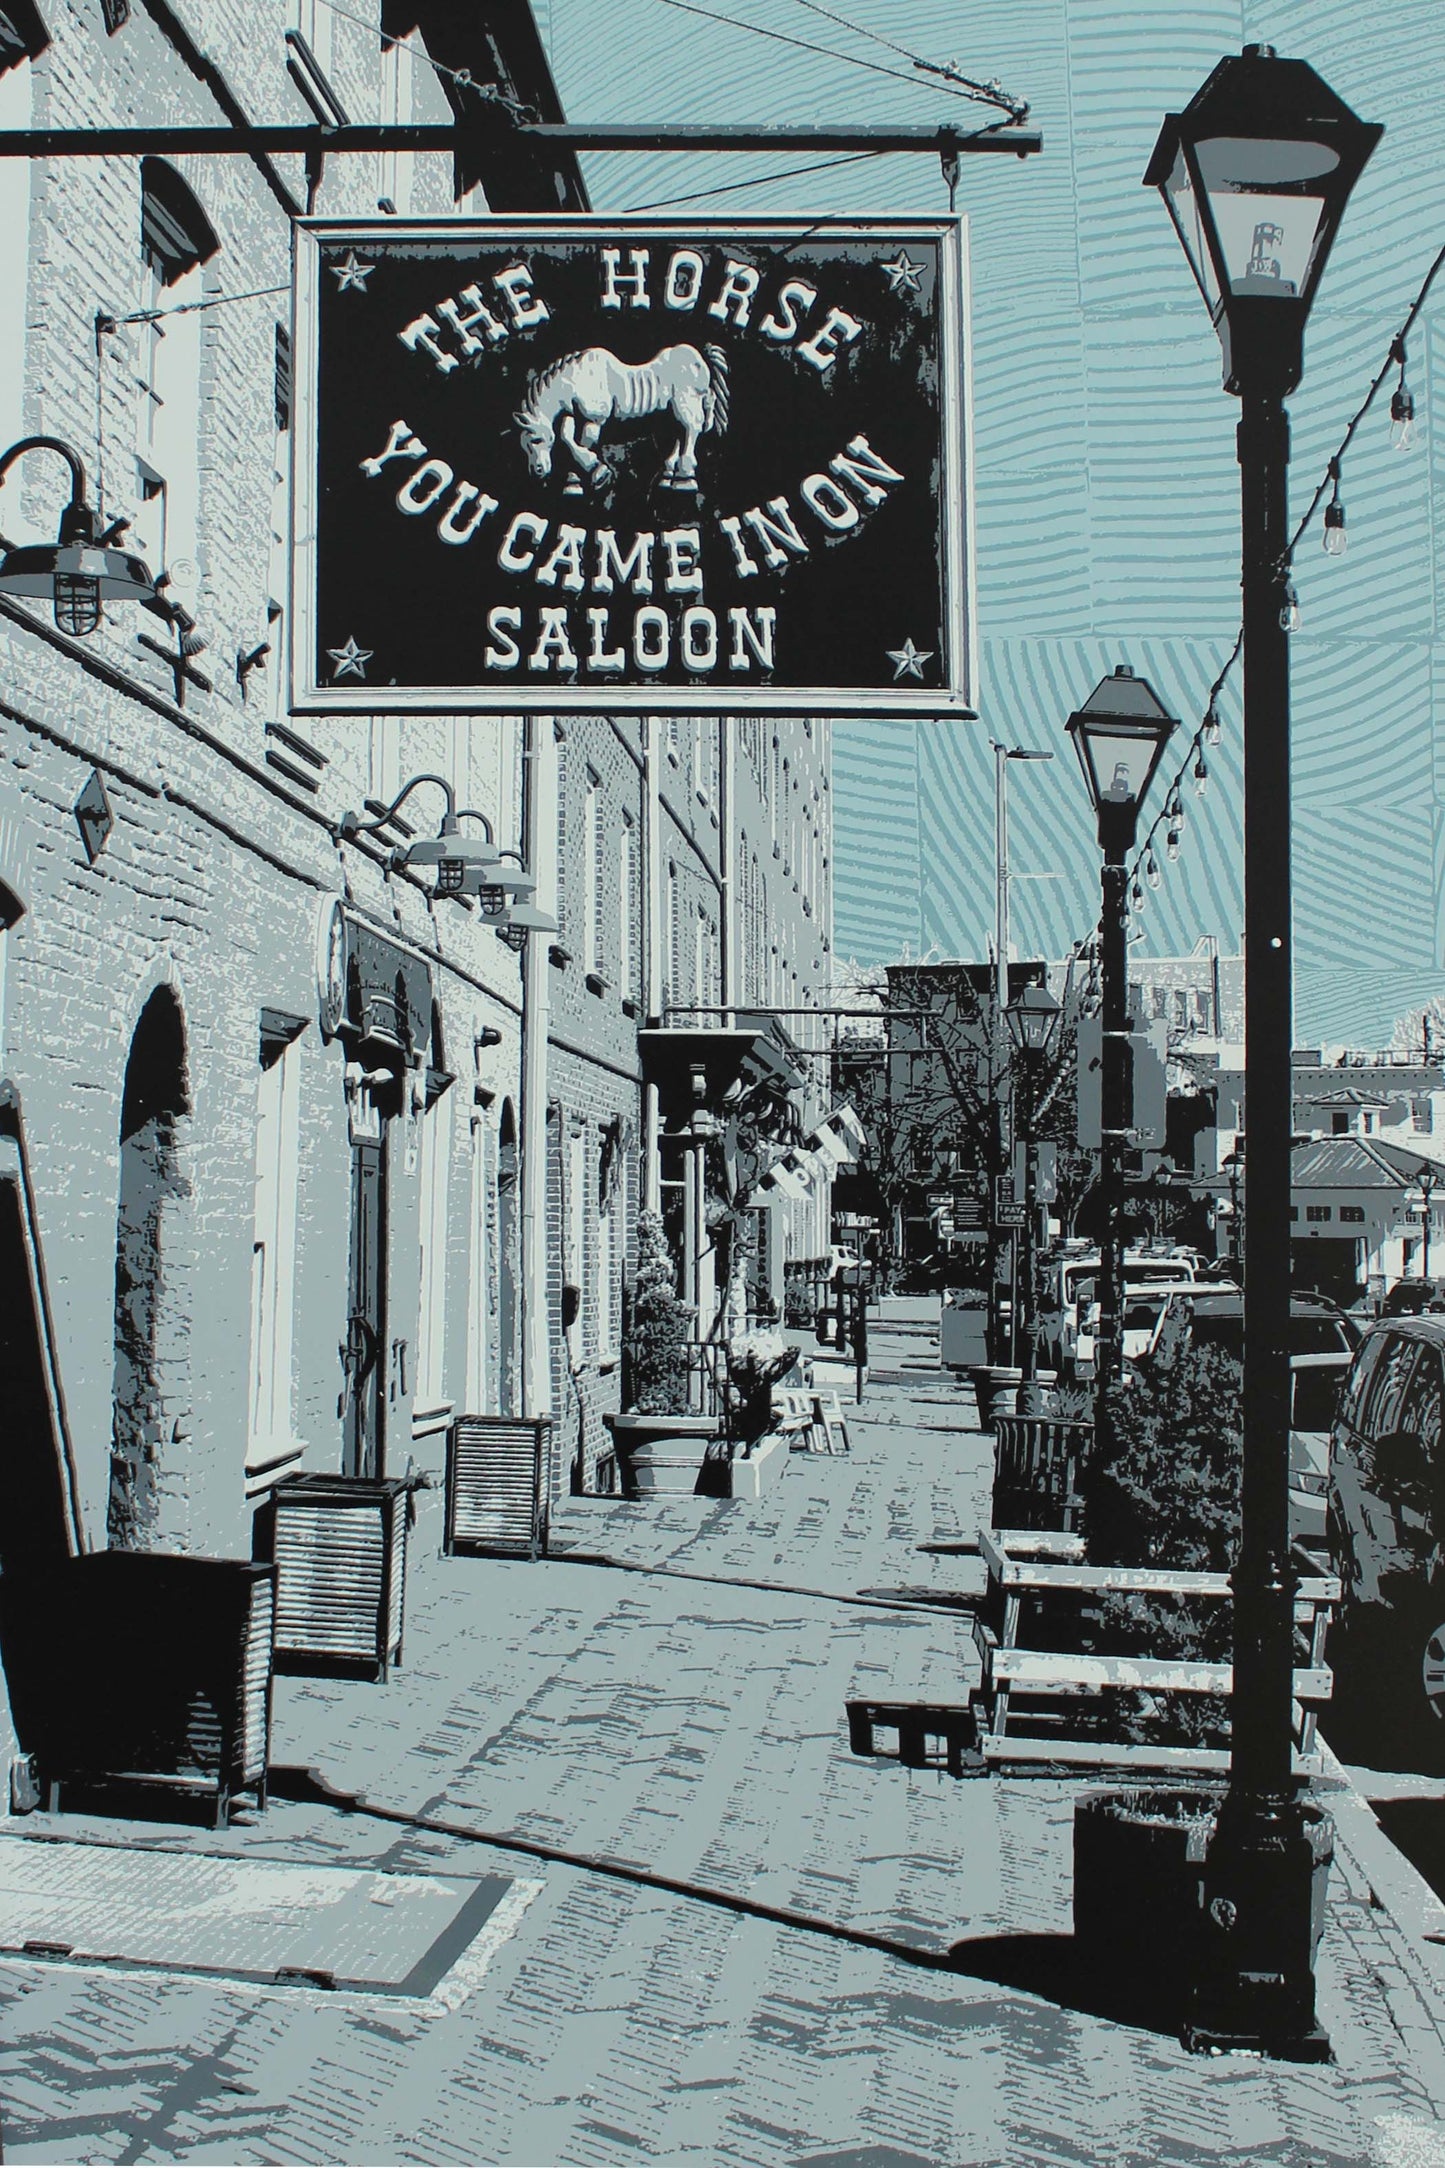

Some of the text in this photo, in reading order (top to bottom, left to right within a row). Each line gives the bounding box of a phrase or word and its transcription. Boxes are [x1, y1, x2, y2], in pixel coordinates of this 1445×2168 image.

[399, 248, 862, 373] THE HORSE
[361, 420, 905, 595] YOU CAME IN ON
[484, 606, 776, 670] SALOON
[1004, 1205, 1022, 1214] PAY
